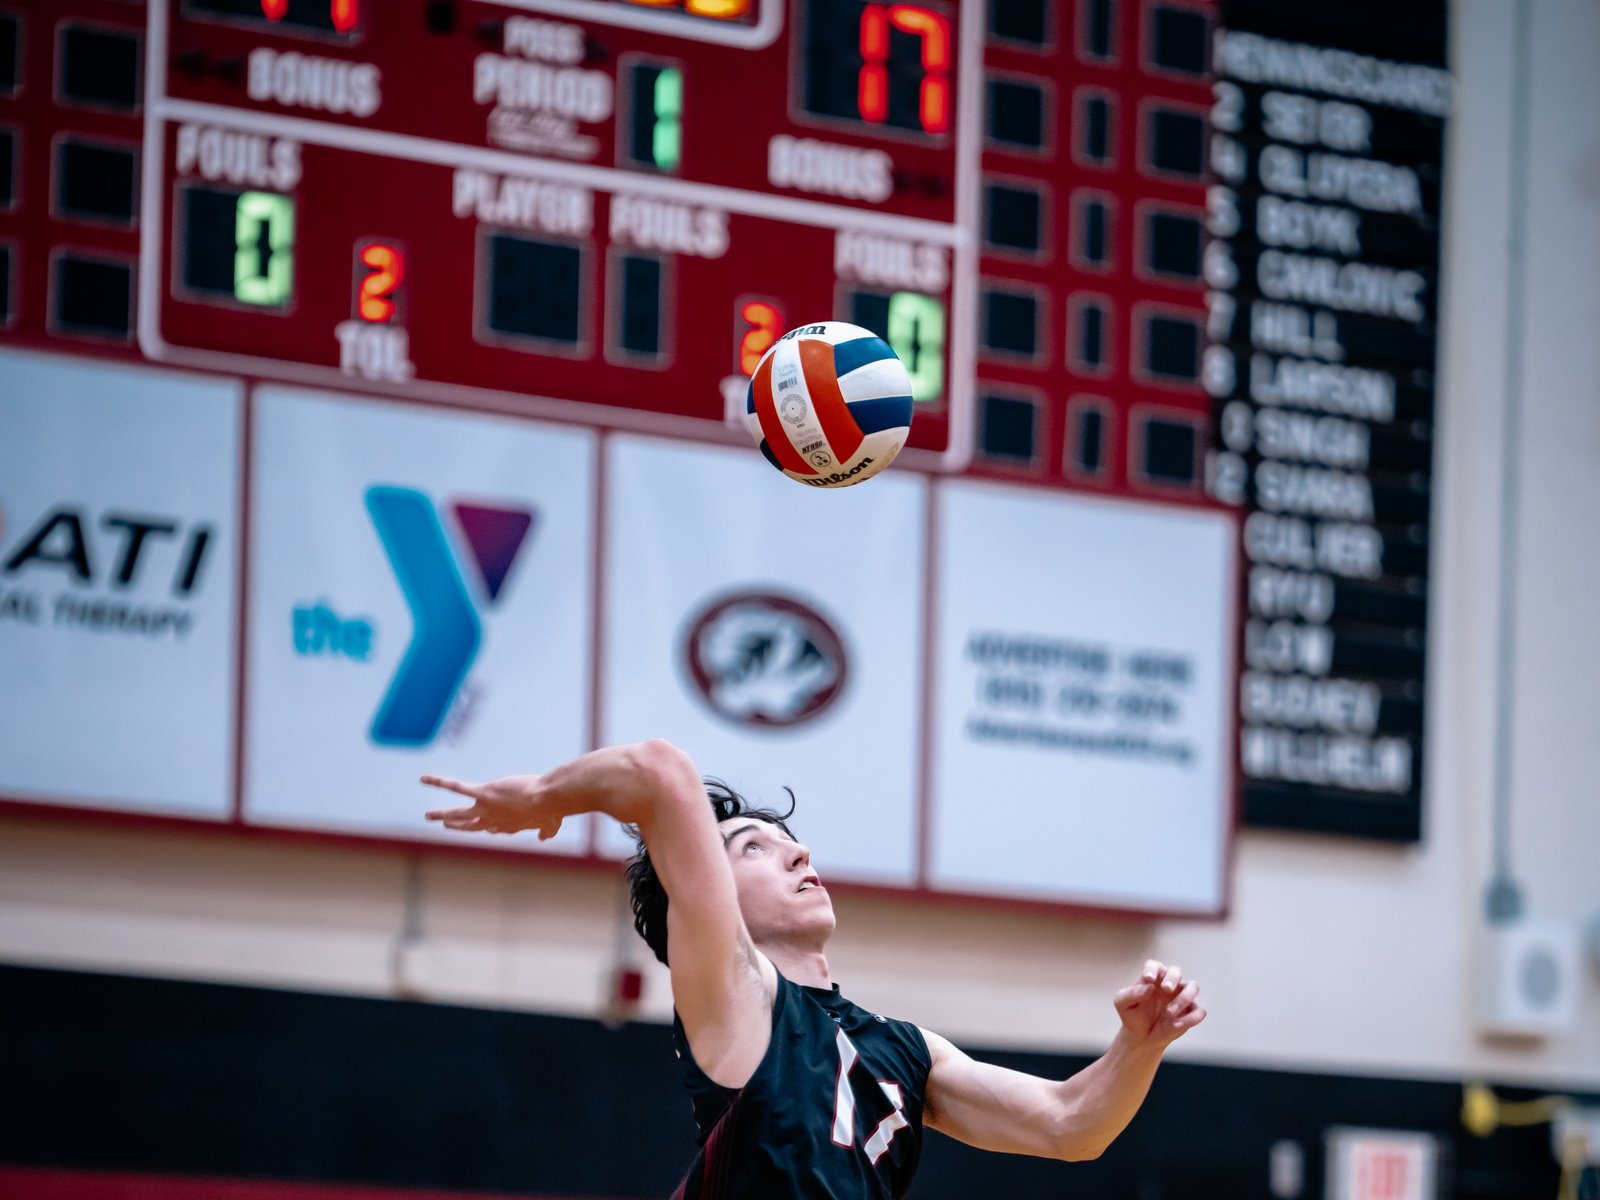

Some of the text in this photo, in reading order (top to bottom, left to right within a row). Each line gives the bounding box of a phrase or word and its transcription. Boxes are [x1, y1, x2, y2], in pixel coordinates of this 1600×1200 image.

[246, 47, 382, 117] BONUS
[473, 52, 613, 123] PERIOD
[858, 3, 952, 135] 17
[652, 66, 683, 170] 1
[176, 124, 303, 188] FOULS
[769, 134, 894, 202] BONUS
[234, 190, 295, 305] 0
[452, 168, 731, 259] PLAYER FOULS
[357, 243, 404, 322] 2
[834, 229, 949, 292] FOULS
[887, 291, 945, 402] 0
[801, 456, 876, 487] Wilson
[3, 505, 217, 597] ATI
[49, 596, 195, 641] THERAPY
[290, 597, 376, 663] the
[831, 1025, 908, 1166] 17
